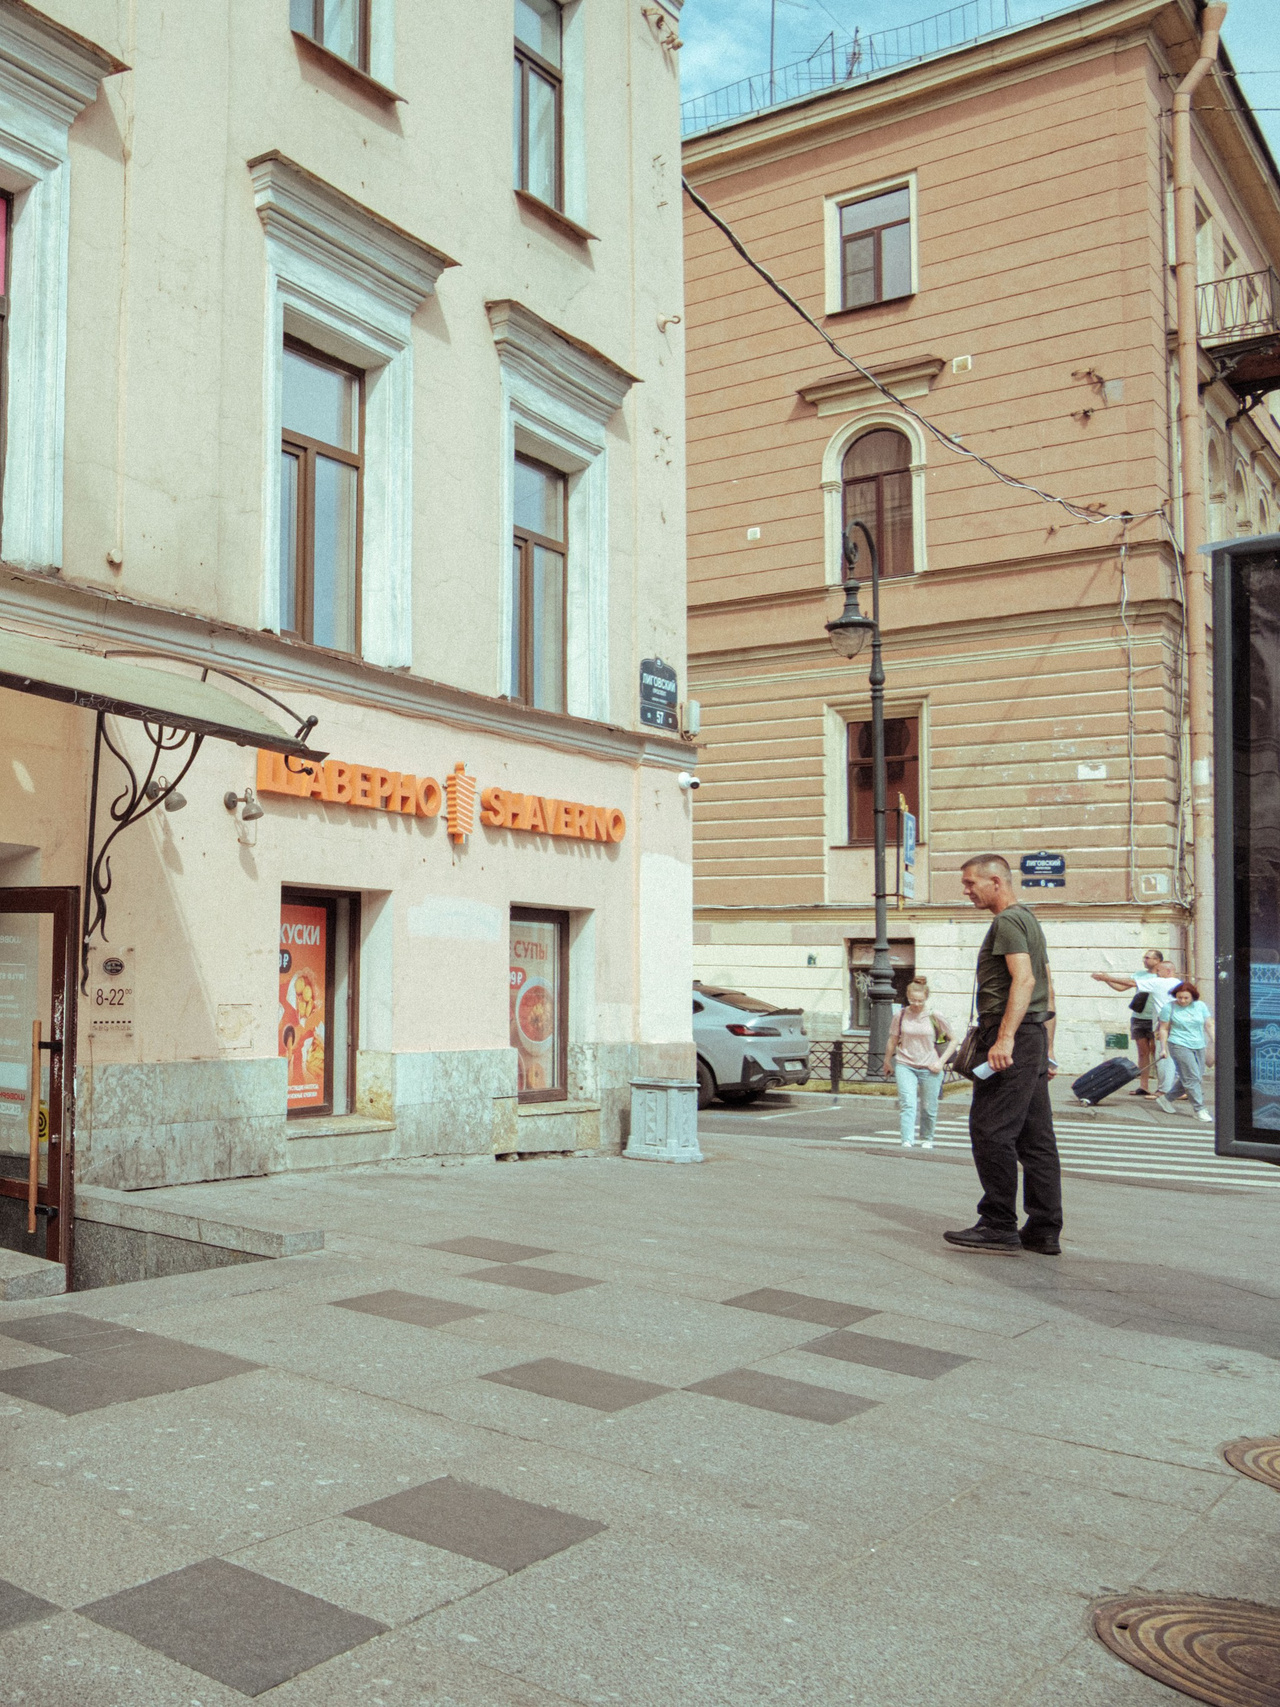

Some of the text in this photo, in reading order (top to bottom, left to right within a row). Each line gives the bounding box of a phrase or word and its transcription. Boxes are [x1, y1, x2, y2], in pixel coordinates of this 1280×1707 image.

[656, 711, 664, 724] 57
[480, 786, 626, 843] SHAVERNO
[1025, 858, 1061, 867] ЛИГОВСКИЙ
[514, 940, 548, 960] СУПЫ
